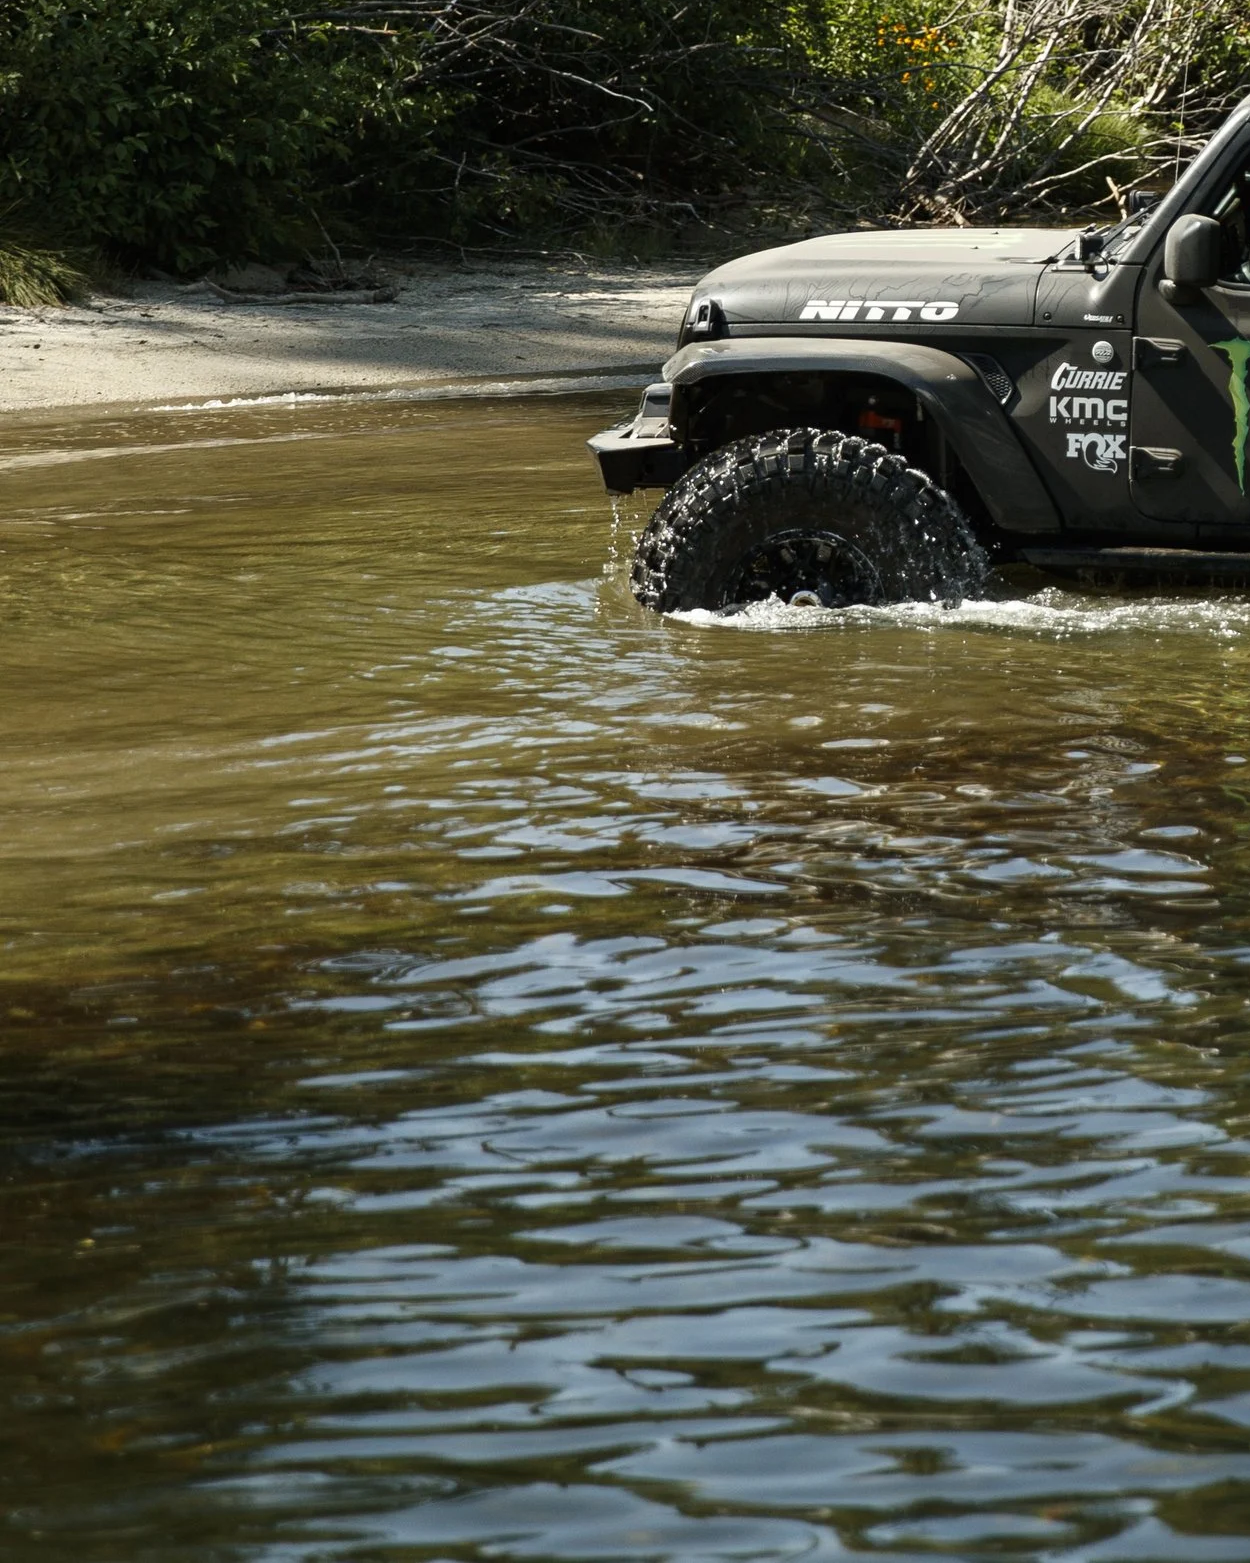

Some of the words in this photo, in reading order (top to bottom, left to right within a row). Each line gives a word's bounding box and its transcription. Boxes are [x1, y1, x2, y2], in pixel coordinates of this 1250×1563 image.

[799, 300, 960, 321] NITTO
[1051, 362, 1128, 391] CURRIE
[1049, 417, 1127, 427] WHEELS
[1066, 432, 1127, 474] FOX
